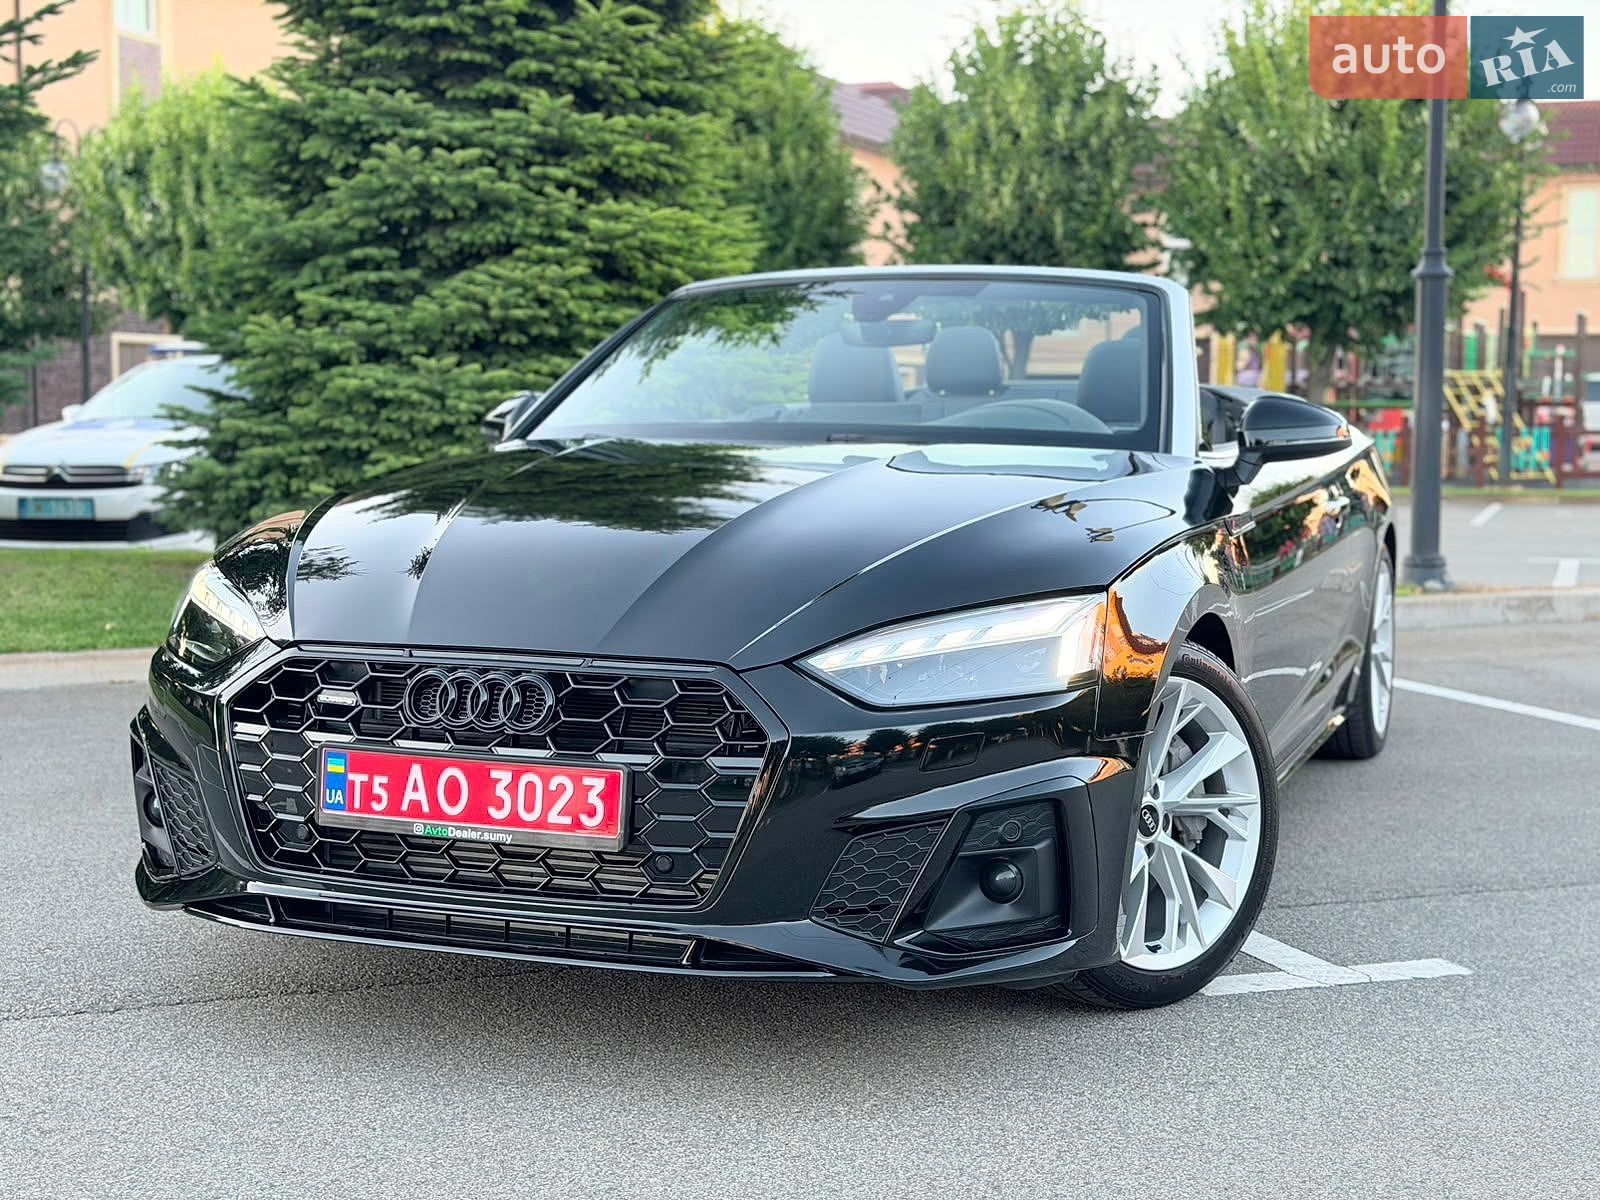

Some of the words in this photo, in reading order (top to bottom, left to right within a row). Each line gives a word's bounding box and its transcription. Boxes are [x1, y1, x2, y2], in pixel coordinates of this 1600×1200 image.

[325, 789, 344, 805] UA
[347, 773, 389, 812] T5
[401, 763, 469, 816] AO
[487, 769, 607, 828] 3023
